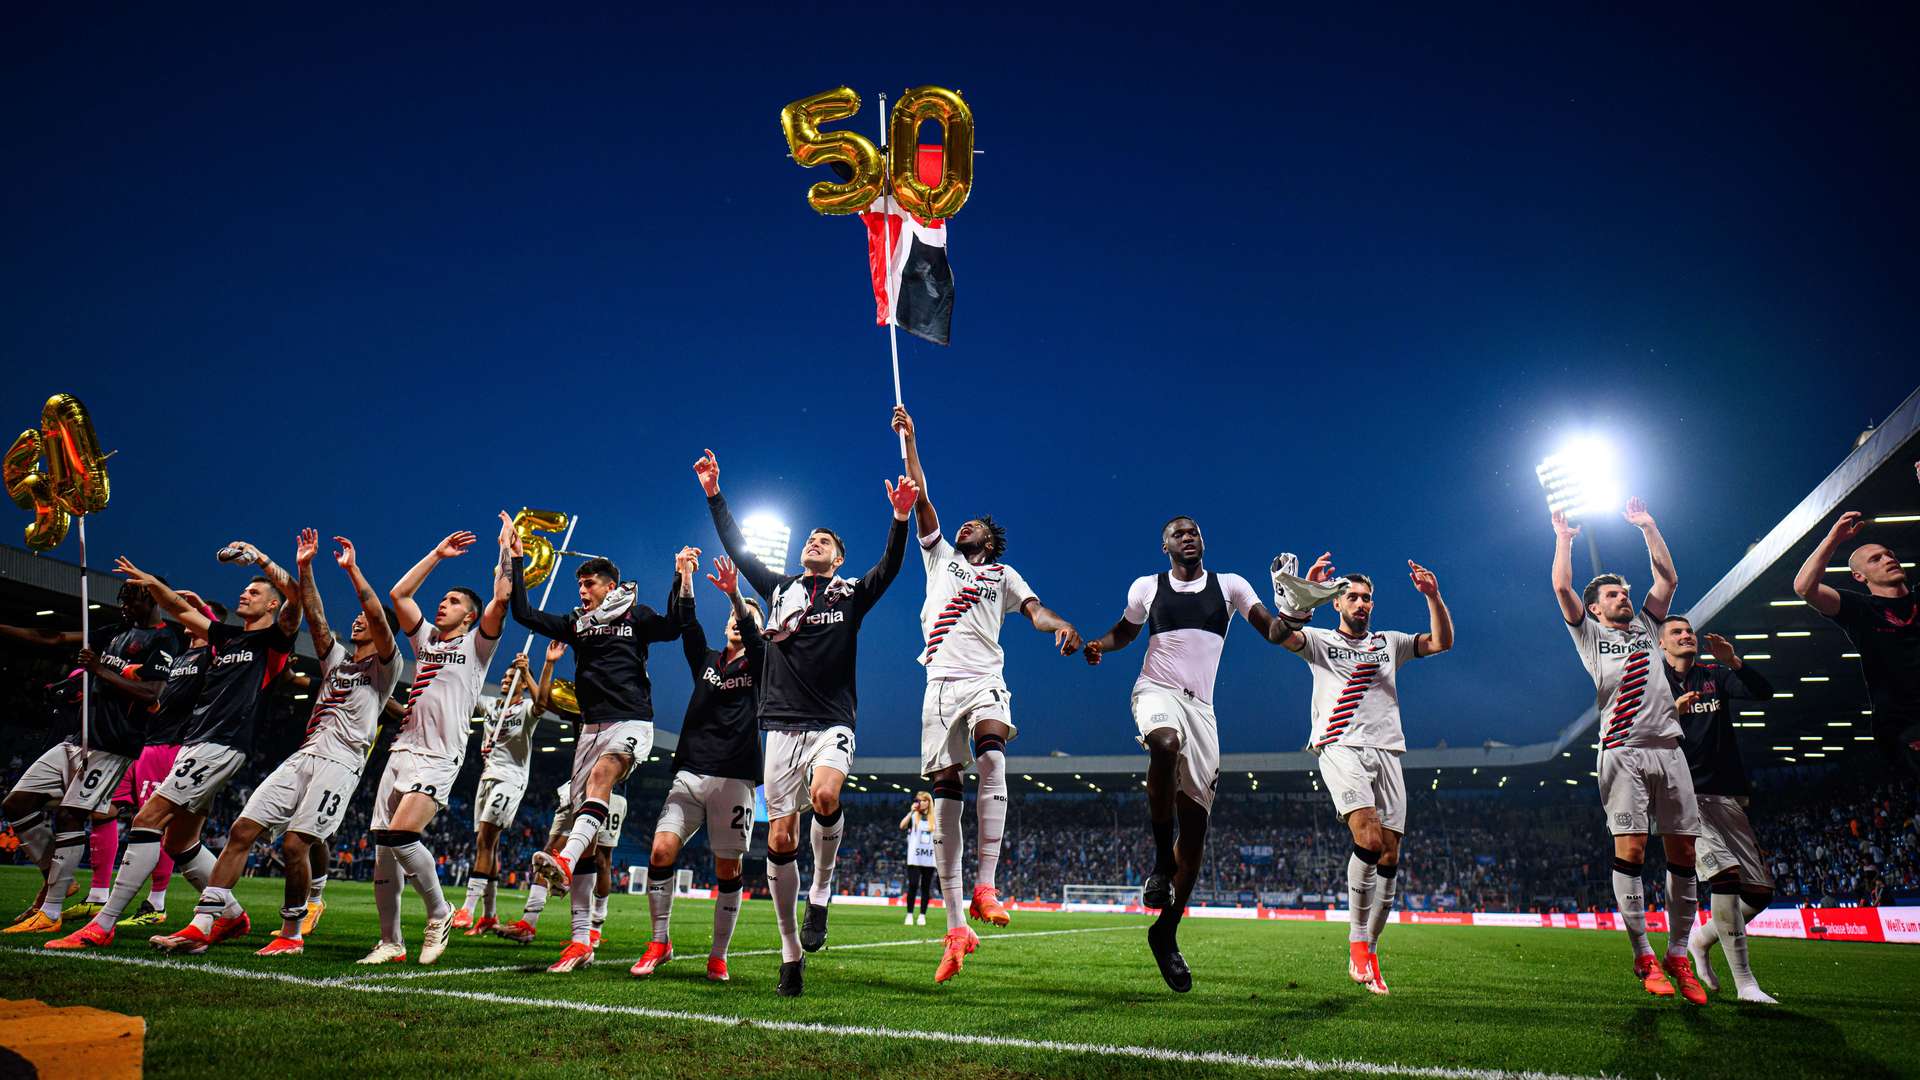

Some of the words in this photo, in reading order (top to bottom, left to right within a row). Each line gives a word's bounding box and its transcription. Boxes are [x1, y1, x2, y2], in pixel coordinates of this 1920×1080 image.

[781, 86, 974, 219] 50
[83, 769, 103, 789] 6
[174, 758, 210, 786] 34
[317, 790, 342, 816] 13
[490, 792, 511, 811] 21
[606, 813, 620, 831] 19
